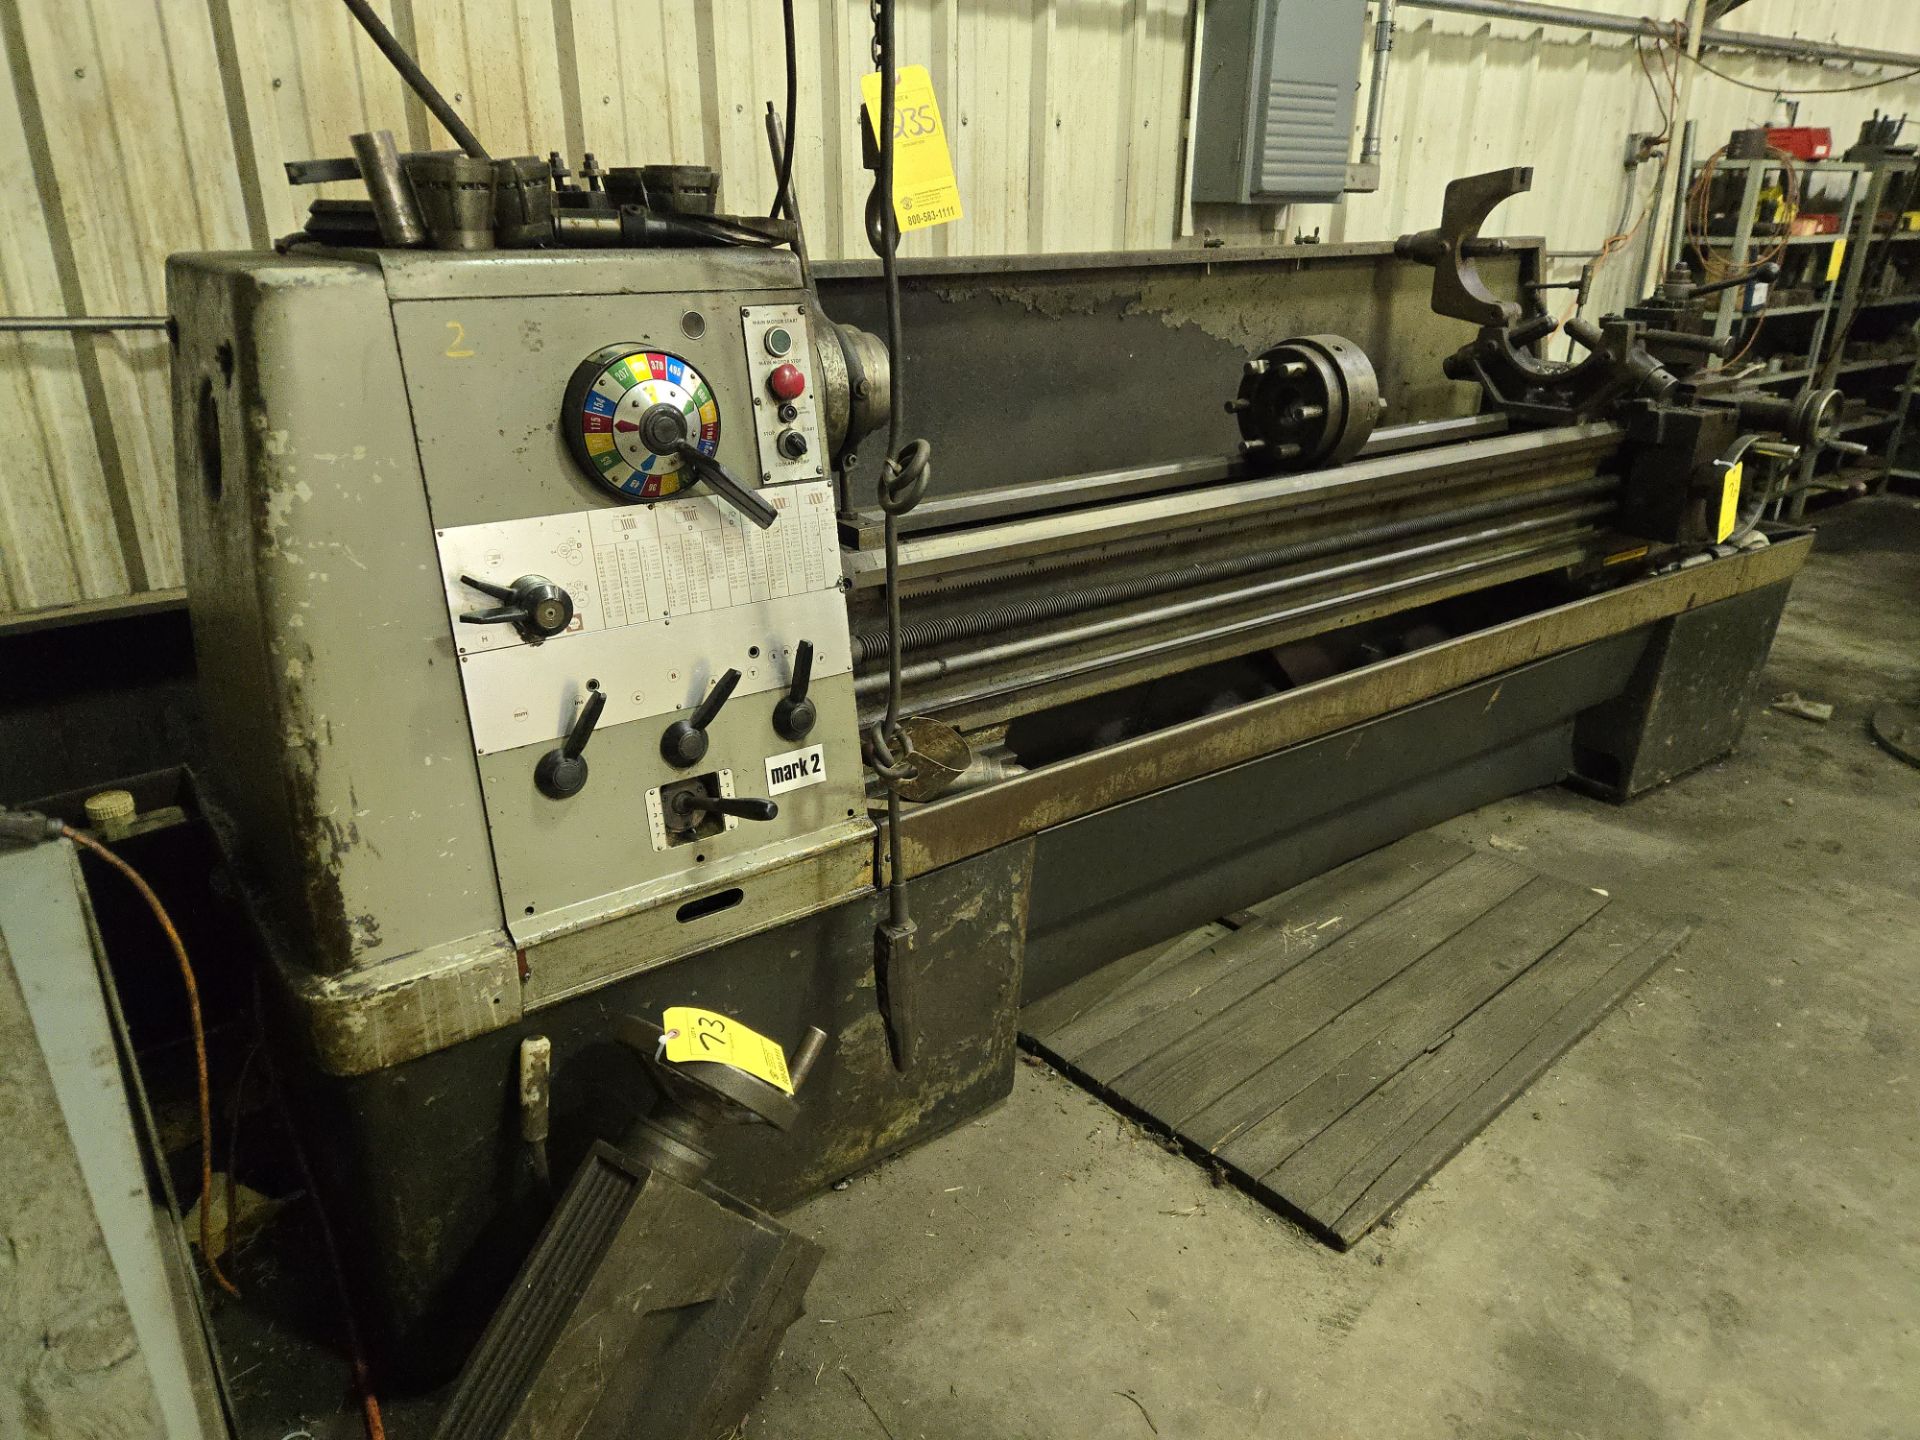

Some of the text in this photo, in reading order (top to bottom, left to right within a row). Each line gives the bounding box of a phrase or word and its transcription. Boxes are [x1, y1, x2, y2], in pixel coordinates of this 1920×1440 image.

[907, 206, 955, 226] 800-583-1111
[446, 321, 475, 357] 2
[614, 367, 630, 380] 207
[771, 753, 821, 785] mark 2
